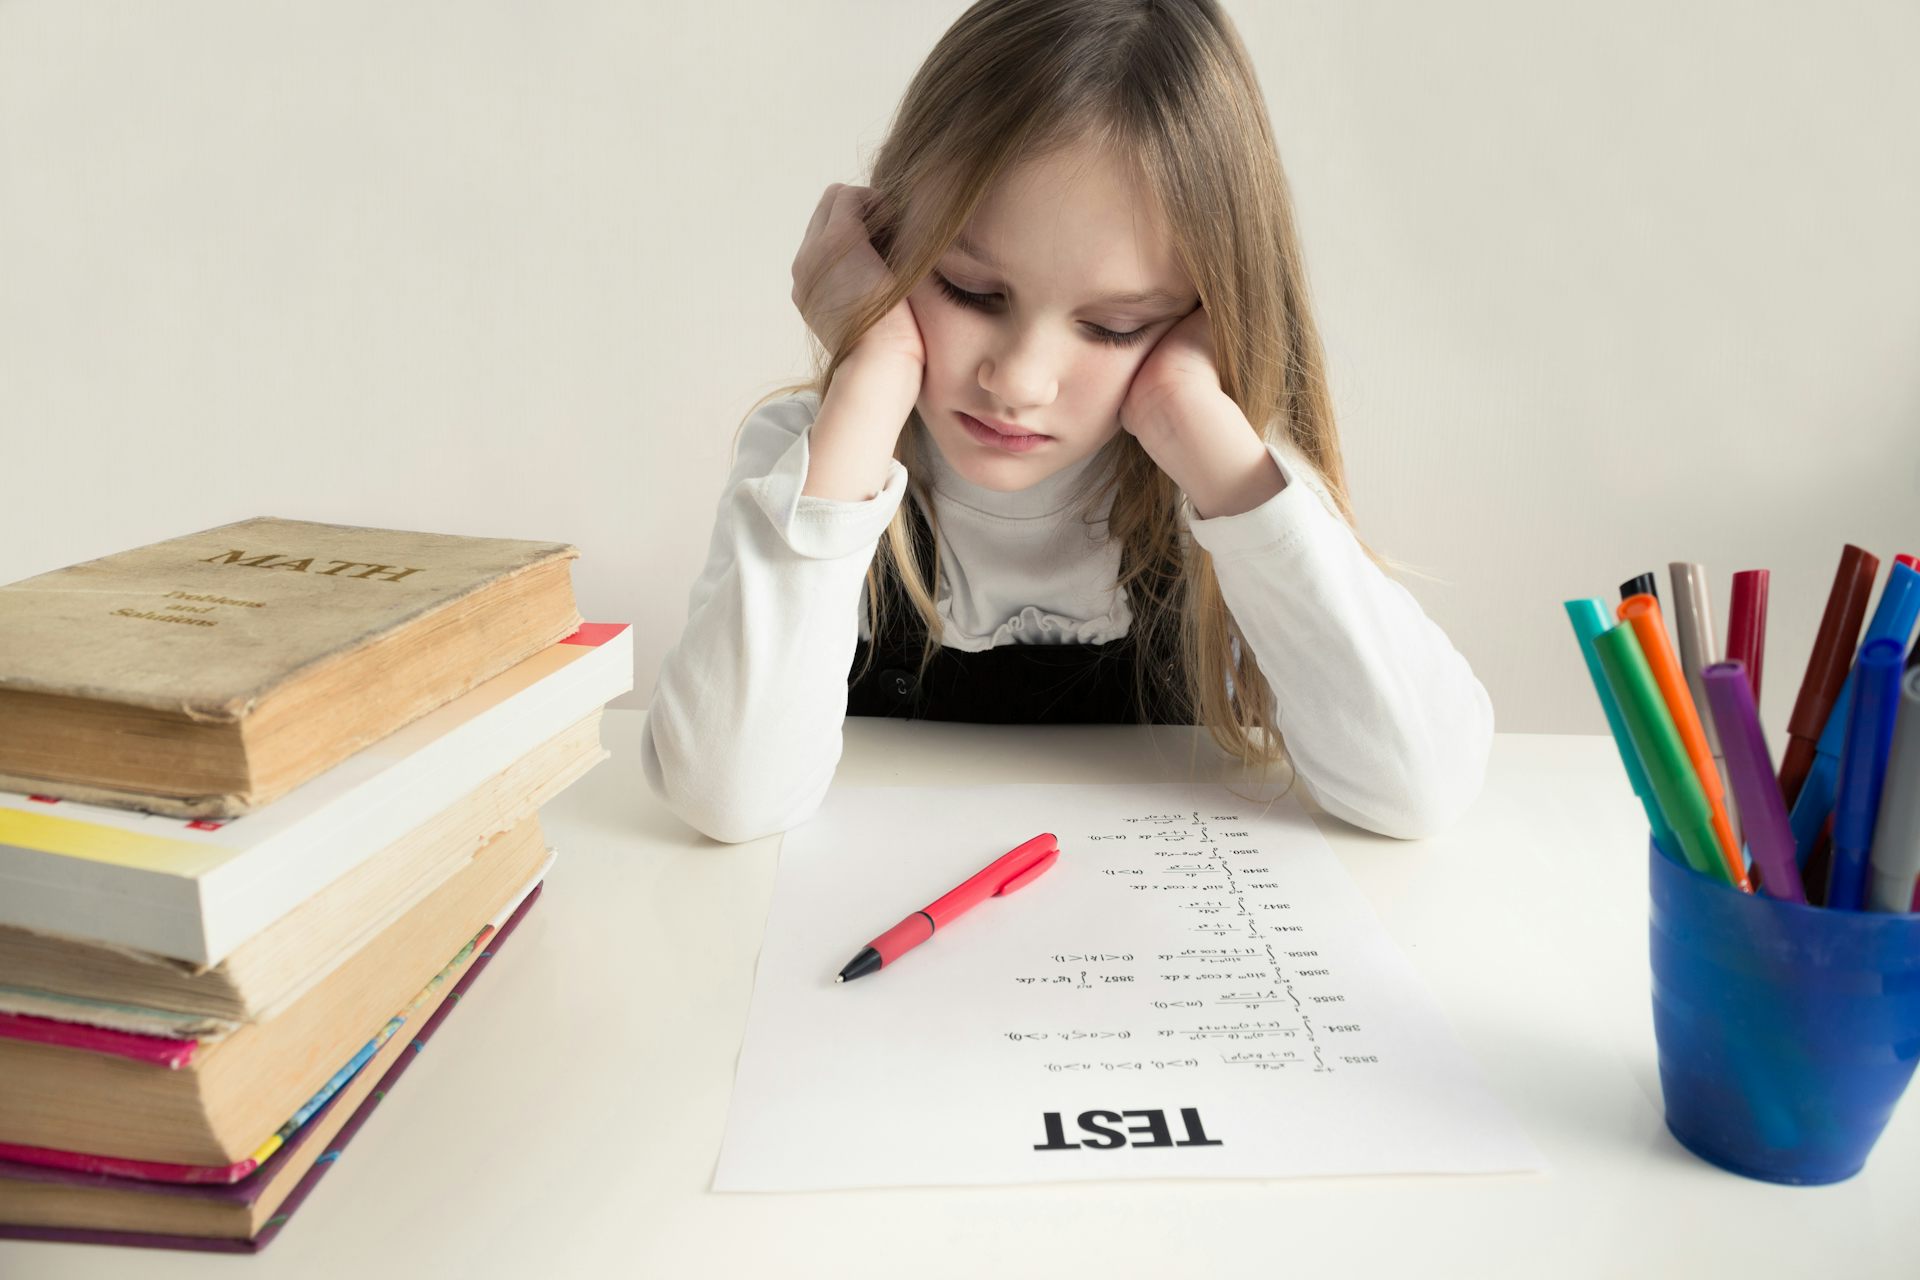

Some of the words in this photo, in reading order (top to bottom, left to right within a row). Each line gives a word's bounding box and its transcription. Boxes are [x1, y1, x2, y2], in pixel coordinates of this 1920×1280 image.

[199, 550, 426, 582] MATH
[109, 607, 220, 627] Solutions
[165, 602, 216, 614] and
[1099, 975, 1135, 984] 3857.
[1032, 1106, 1224, 1152] TEST
